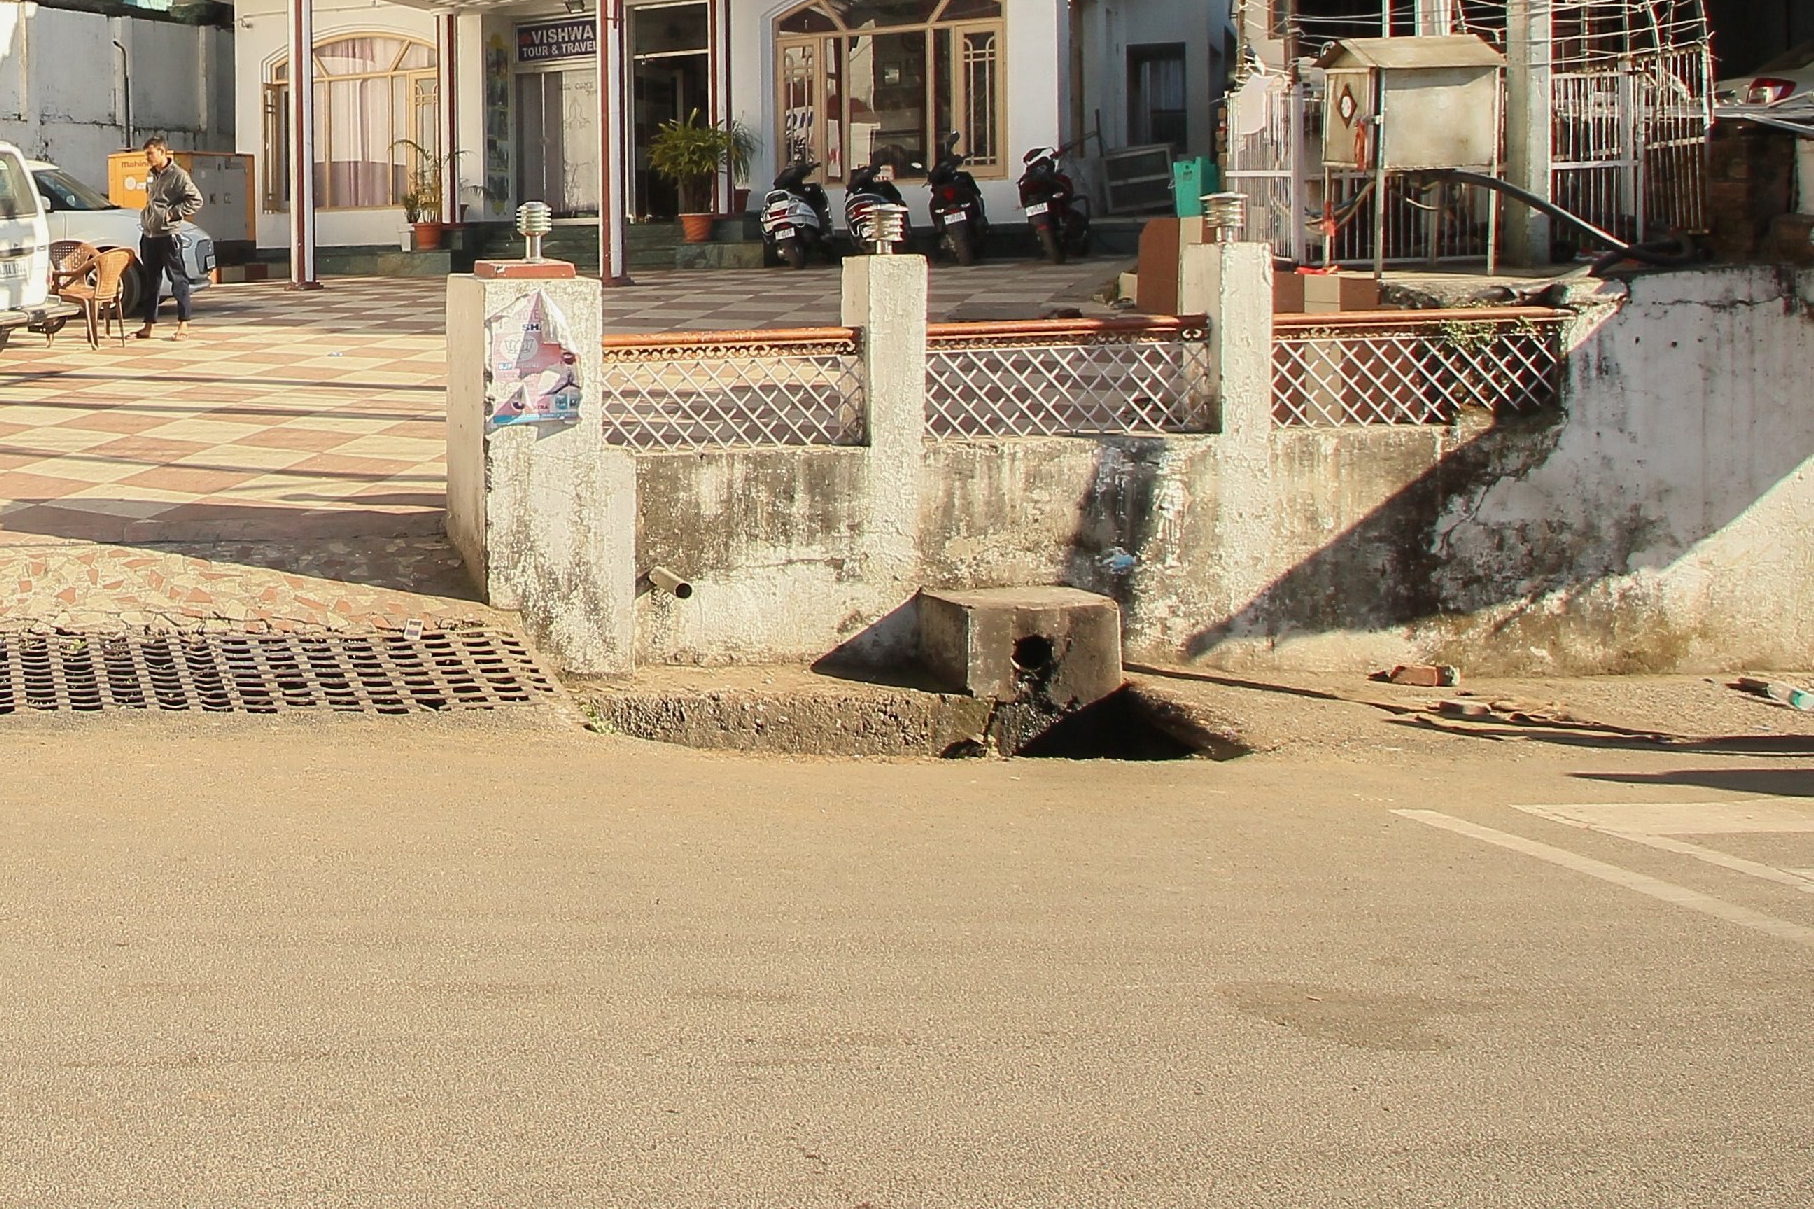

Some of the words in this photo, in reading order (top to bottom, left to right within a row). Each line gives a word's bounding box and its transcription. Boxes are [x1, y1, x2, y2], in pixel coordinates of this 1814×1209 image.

[532, 25, 594, 44] VISHWA
[522, 45, 549, 58] TOUR
[551, 44, 559, 55] &
